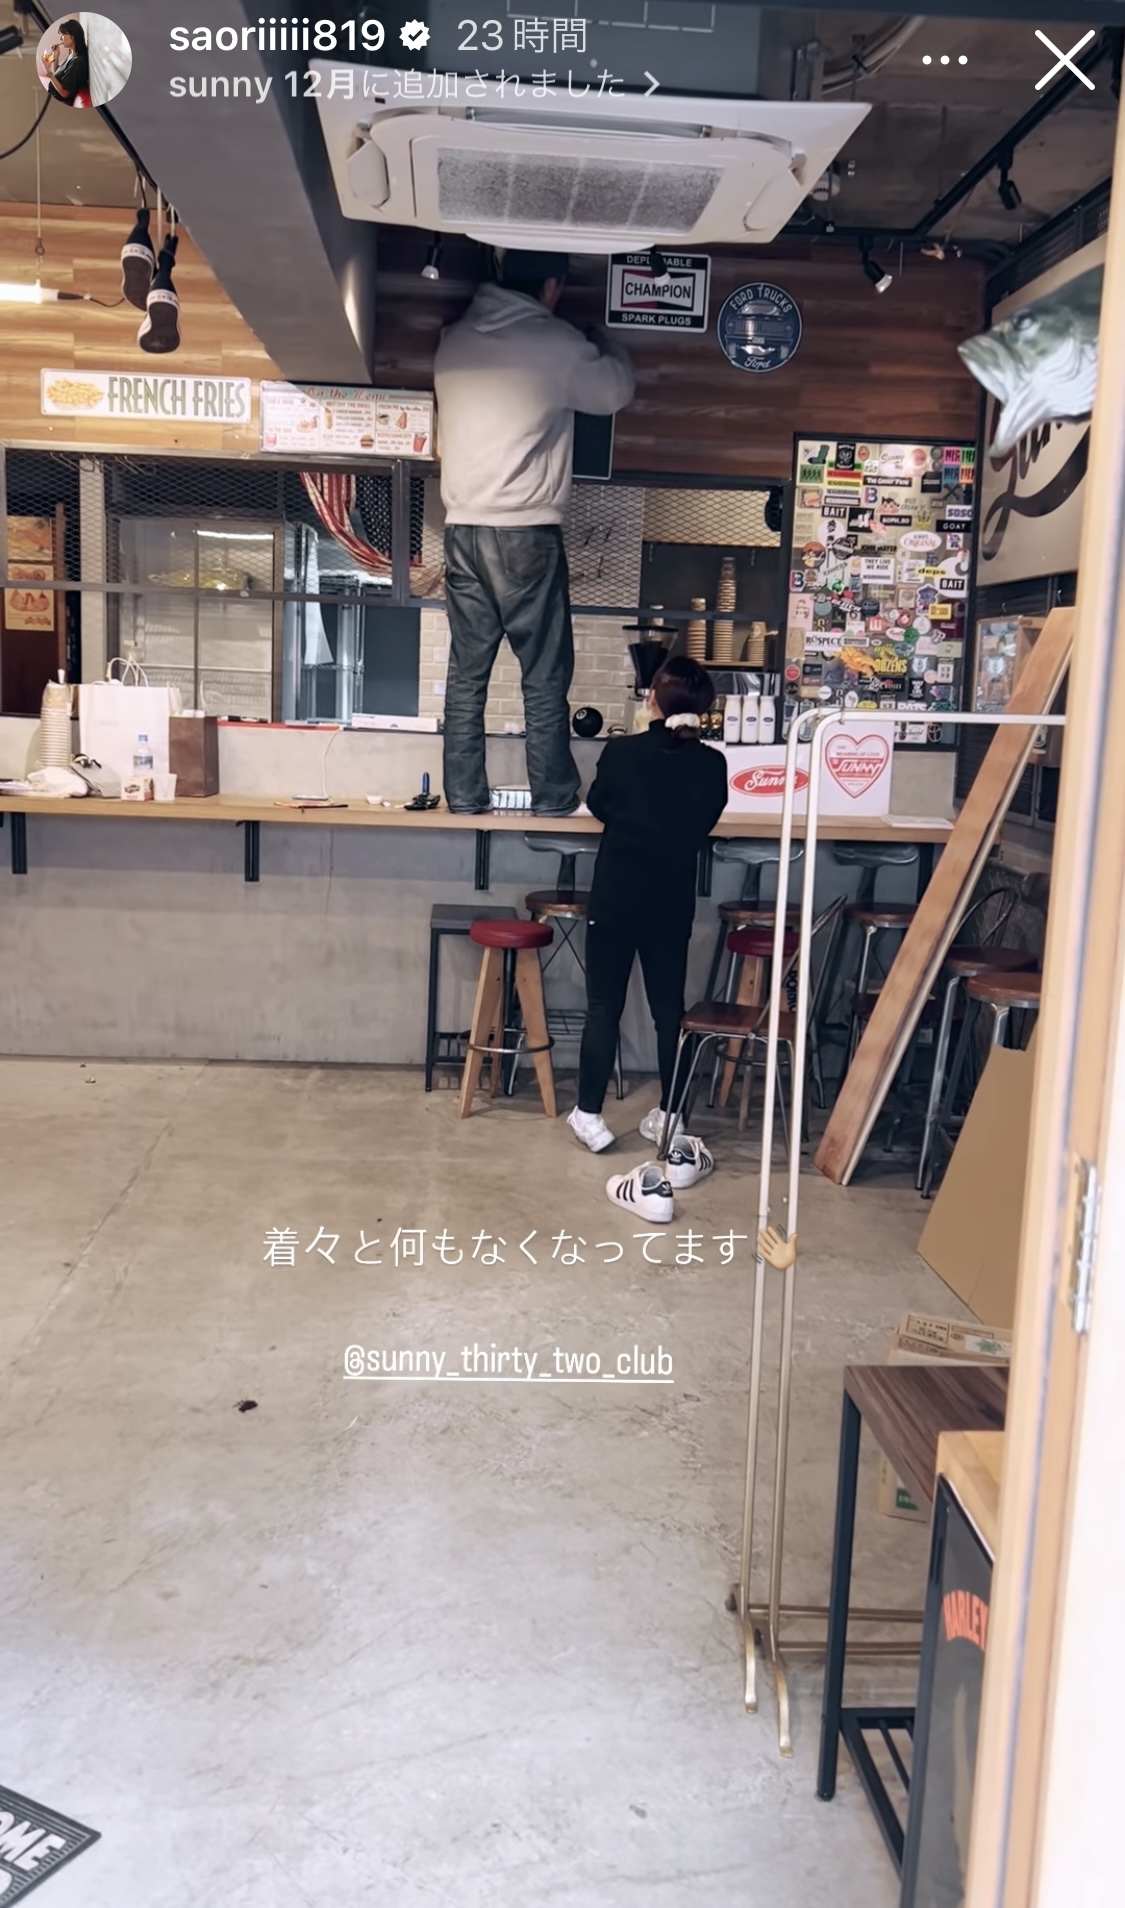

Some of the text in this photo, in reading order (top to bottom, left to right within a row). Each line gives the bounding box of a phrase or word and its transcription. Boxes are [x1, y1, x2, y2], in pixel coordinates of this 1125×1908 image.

[624, 281, 692, 299] CHAMPION
[729, 285, 793, 313] FORD TRUCKS
[621, 313, 692, 326] SPARK PLUGS
[744, 355, 771, 370] Ford
[107, 376, 246, 420] FRENCH FRIES
[823, 507, 845, 517] BAIT
[942, 522, 966, 530] GOAT
[941, 579, 963, 589] BAIT
